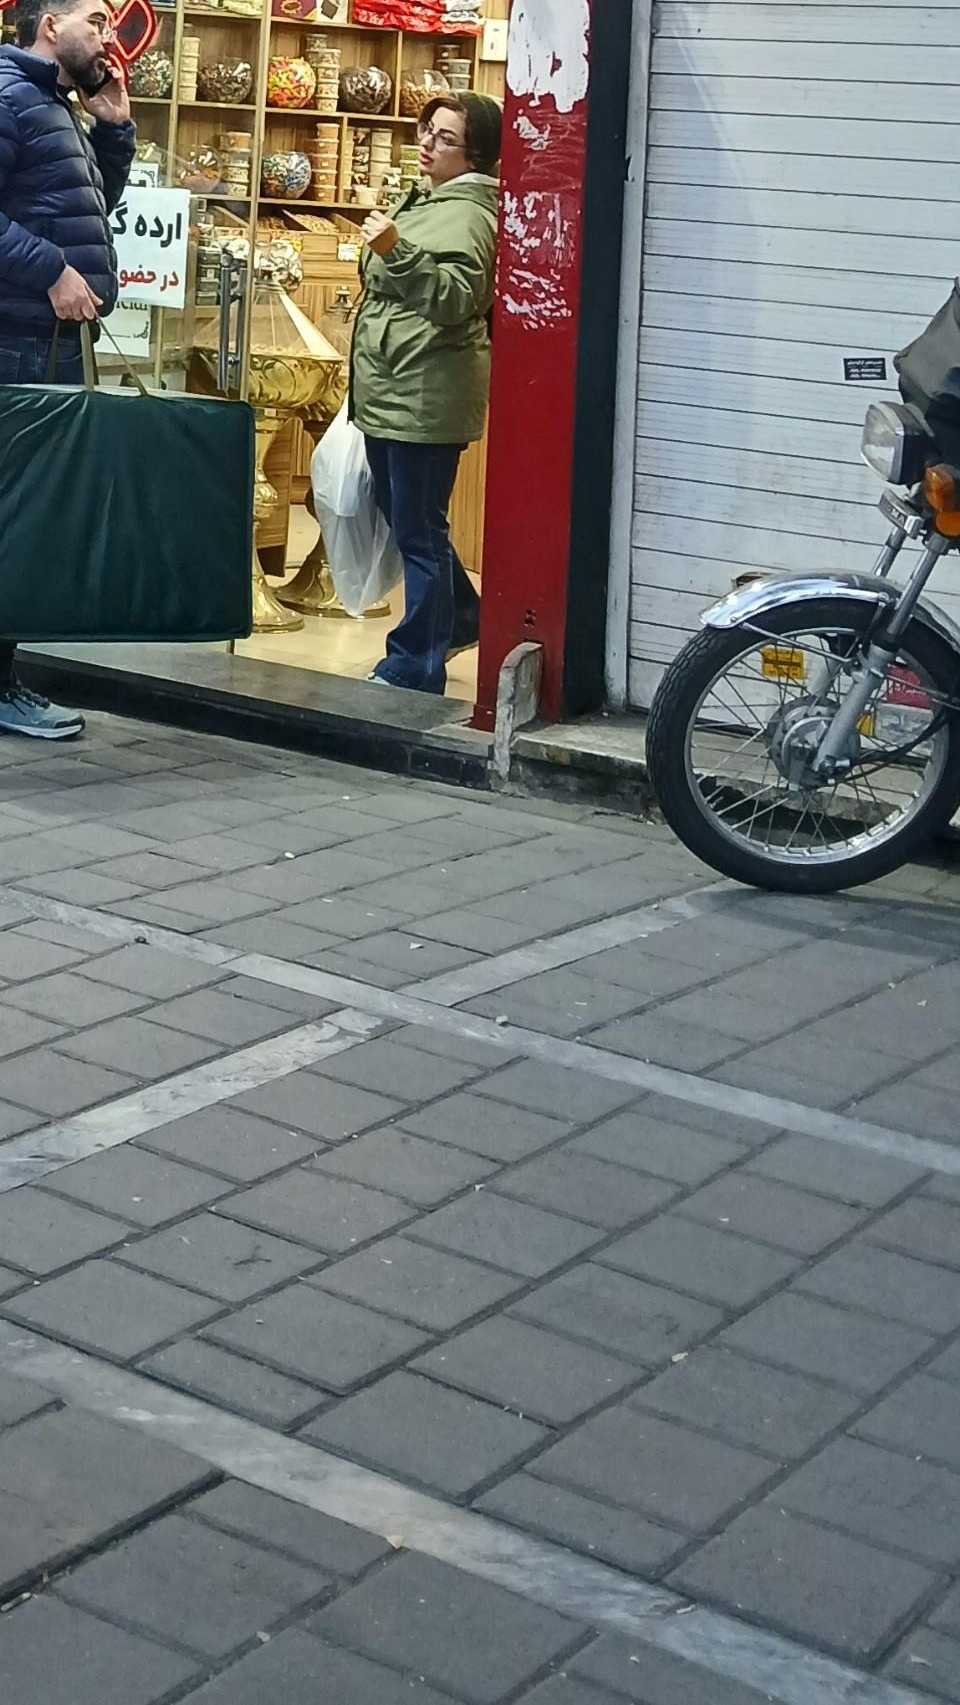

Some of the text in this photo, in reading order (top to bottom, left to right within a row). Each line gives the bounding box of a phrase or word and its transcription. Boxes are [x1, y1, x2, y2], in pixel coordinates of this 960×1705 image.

[134, 213, 182, 248] ارده
[119, 264, 179, 292] در حضو
